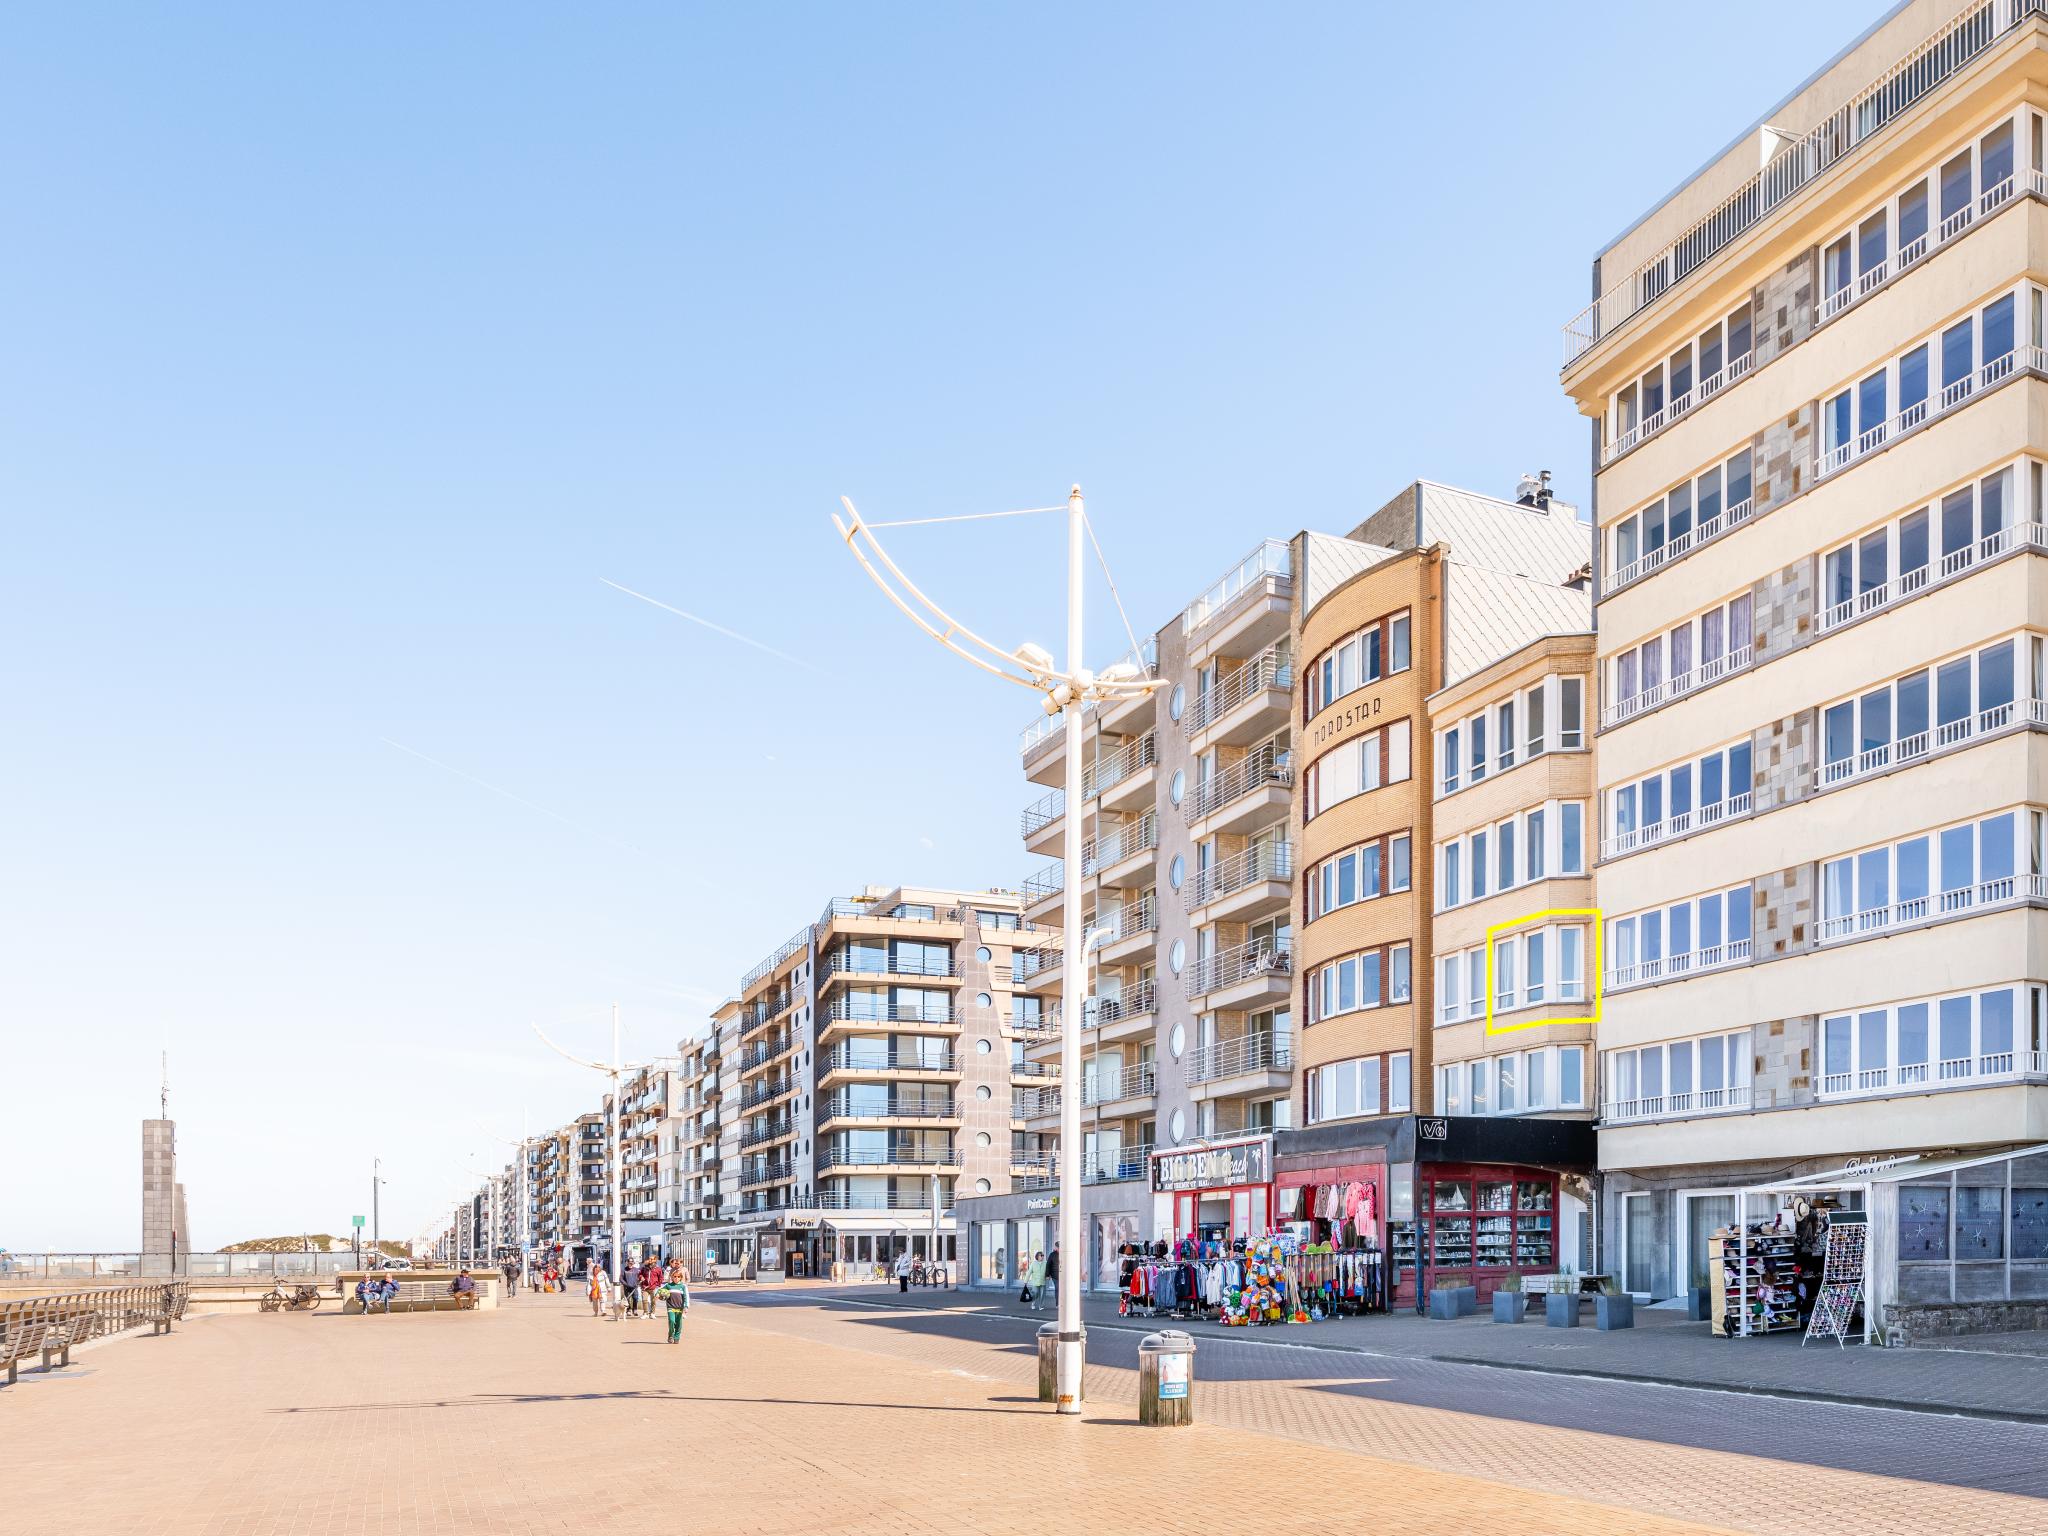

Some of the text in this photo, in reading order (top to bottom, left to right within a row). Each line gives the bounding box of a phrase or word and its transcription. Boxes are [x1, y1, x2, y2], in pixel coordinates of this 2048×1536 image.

[1313, 697, 1382, 747] NORDSTAR
[1160, 1157, 1184, 1182] BIG
[1187, 1151, 1218, 1180] BEN
